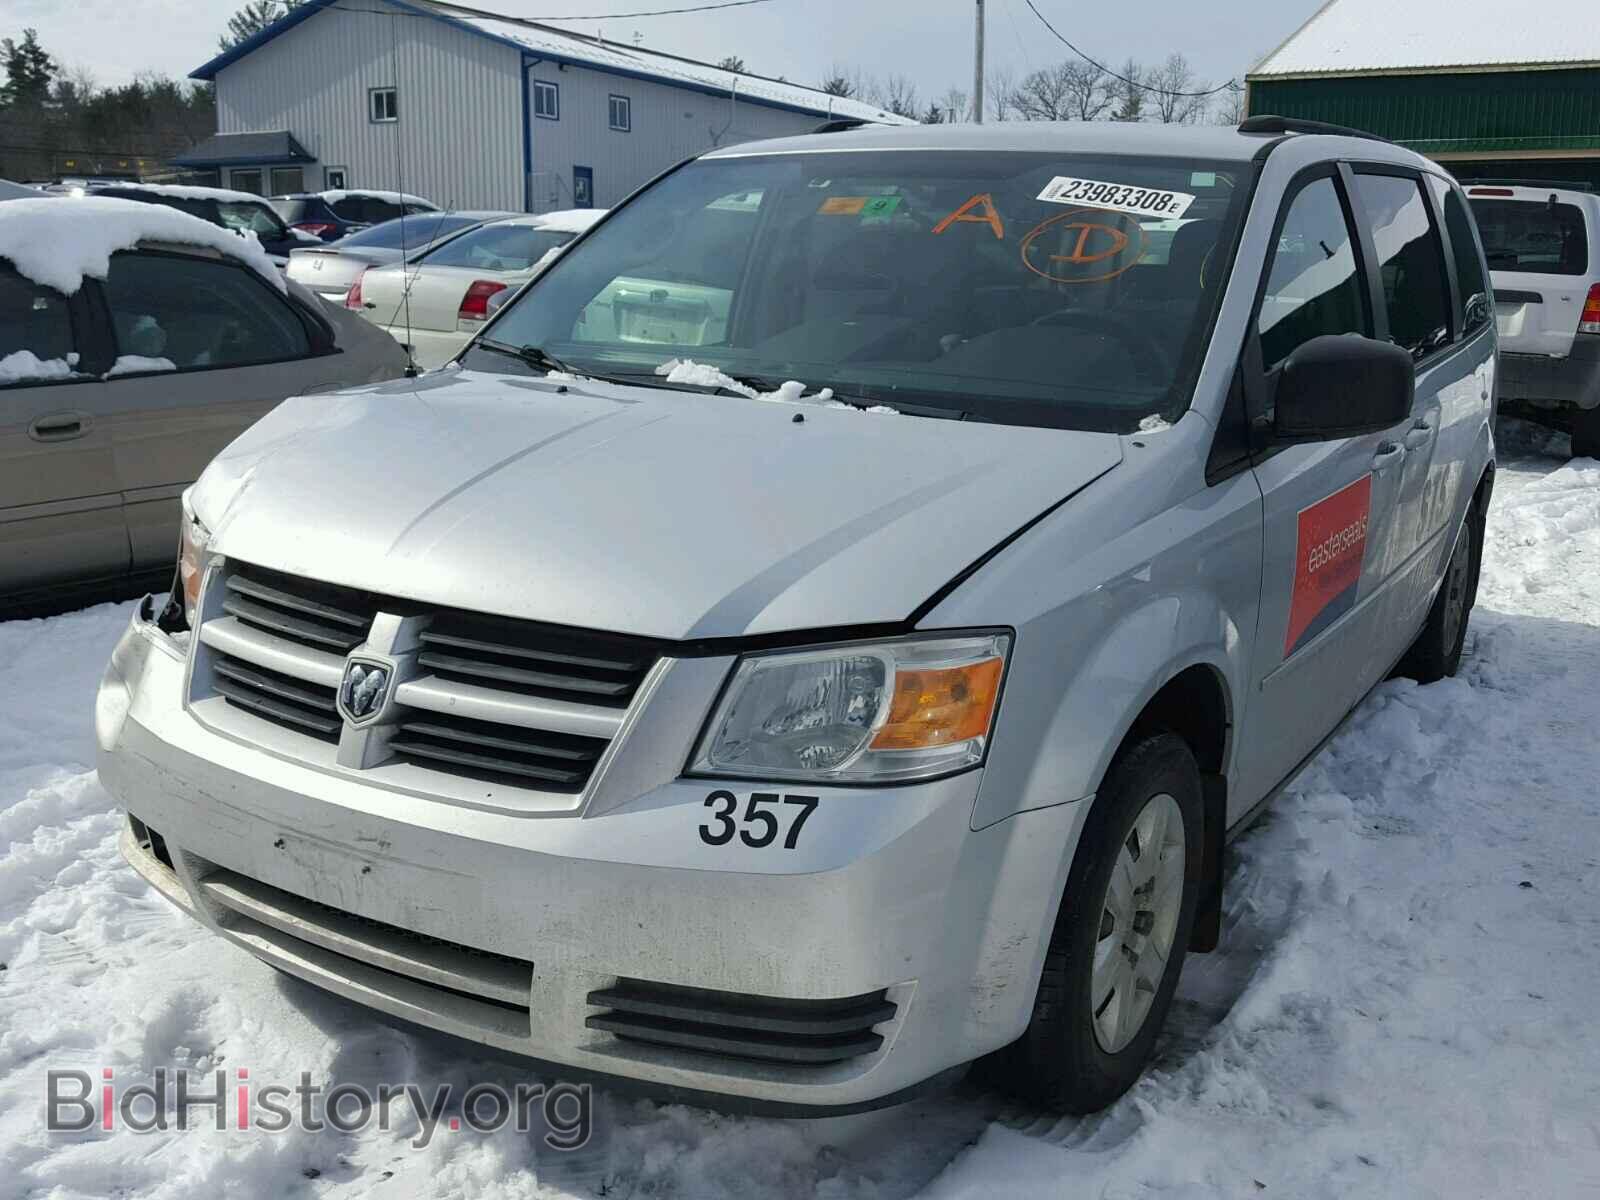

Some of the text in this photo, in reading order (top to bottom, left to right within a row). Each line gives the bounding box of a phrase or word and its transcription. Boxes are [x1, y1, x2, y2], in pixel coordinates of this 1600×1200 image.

[932, 193, 1003, 239] A
[1308, 514, 1369, 574] easterseals
[698, 789, 820, 850] 357
